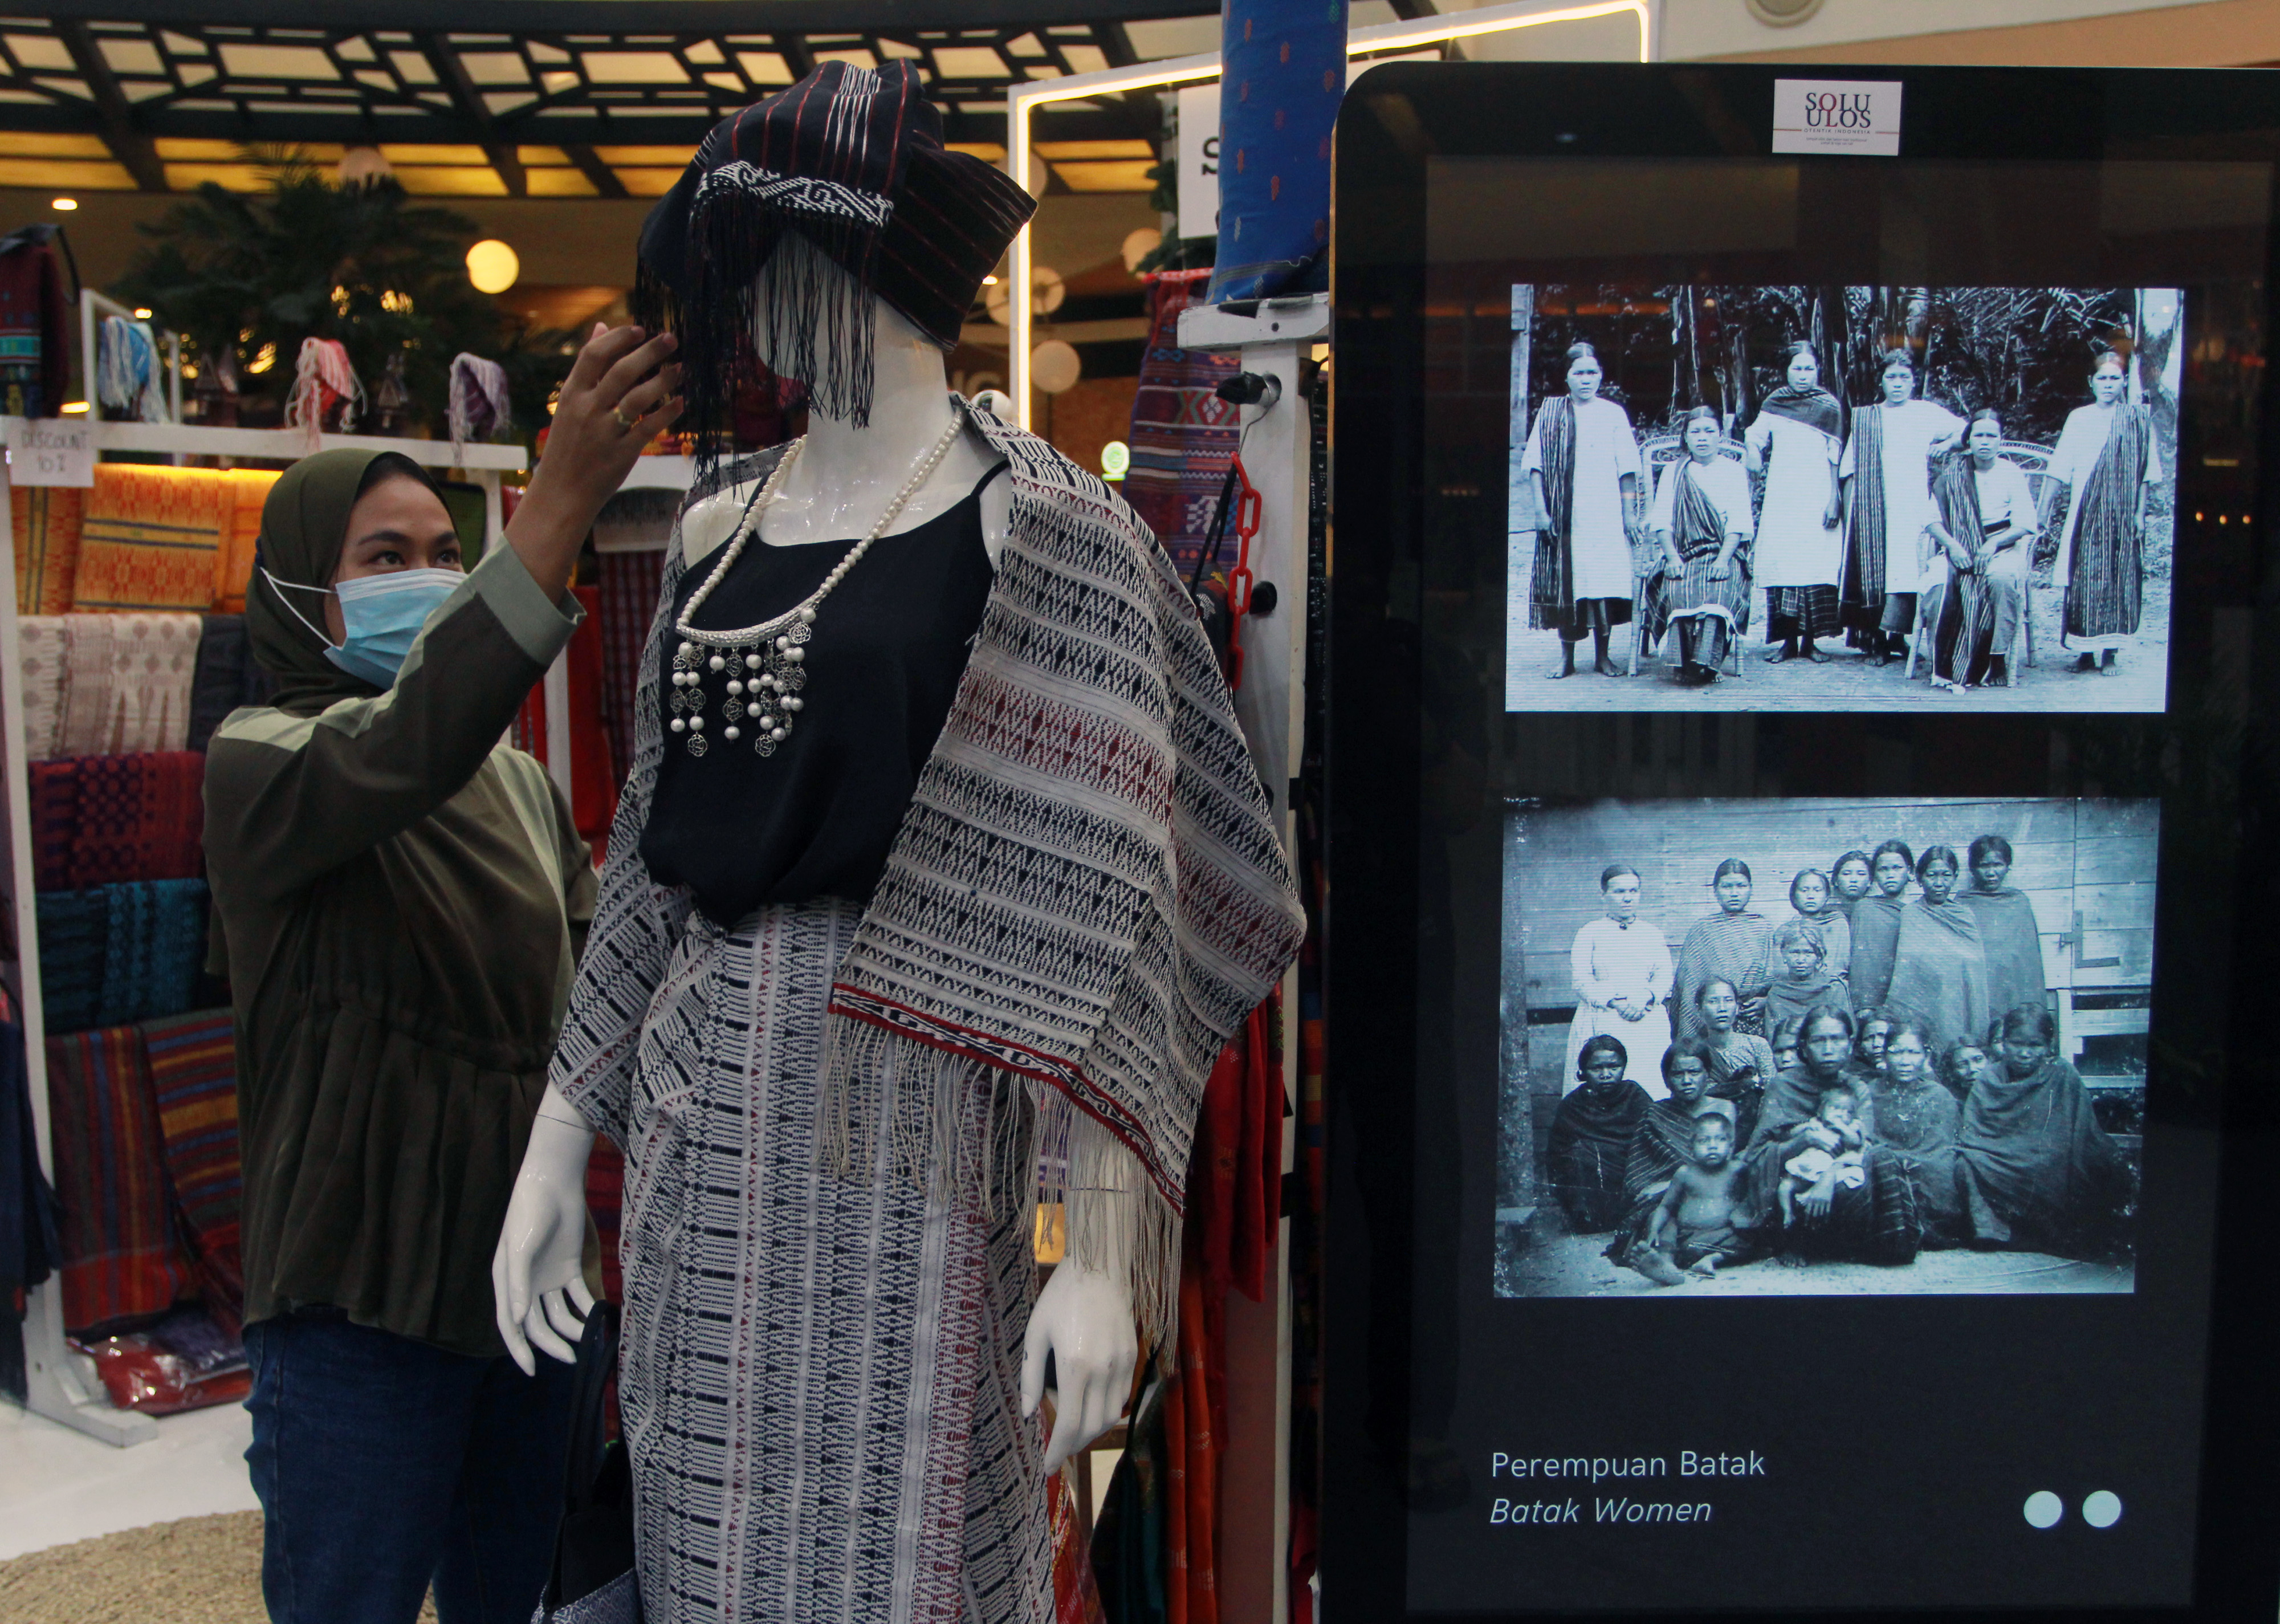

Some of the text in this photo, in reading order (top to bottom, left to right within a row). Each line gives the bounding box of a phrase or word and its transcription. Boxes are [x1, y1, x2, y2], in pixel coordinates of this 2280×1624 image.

[1805, 92, 1871, 112] SOLU
[1806, 108, 1871, 128] ULOS
[1492, 1450, 1765, 1483] Perempuan Batak
[1489, 1497, 1712, 1523] Batak Women
